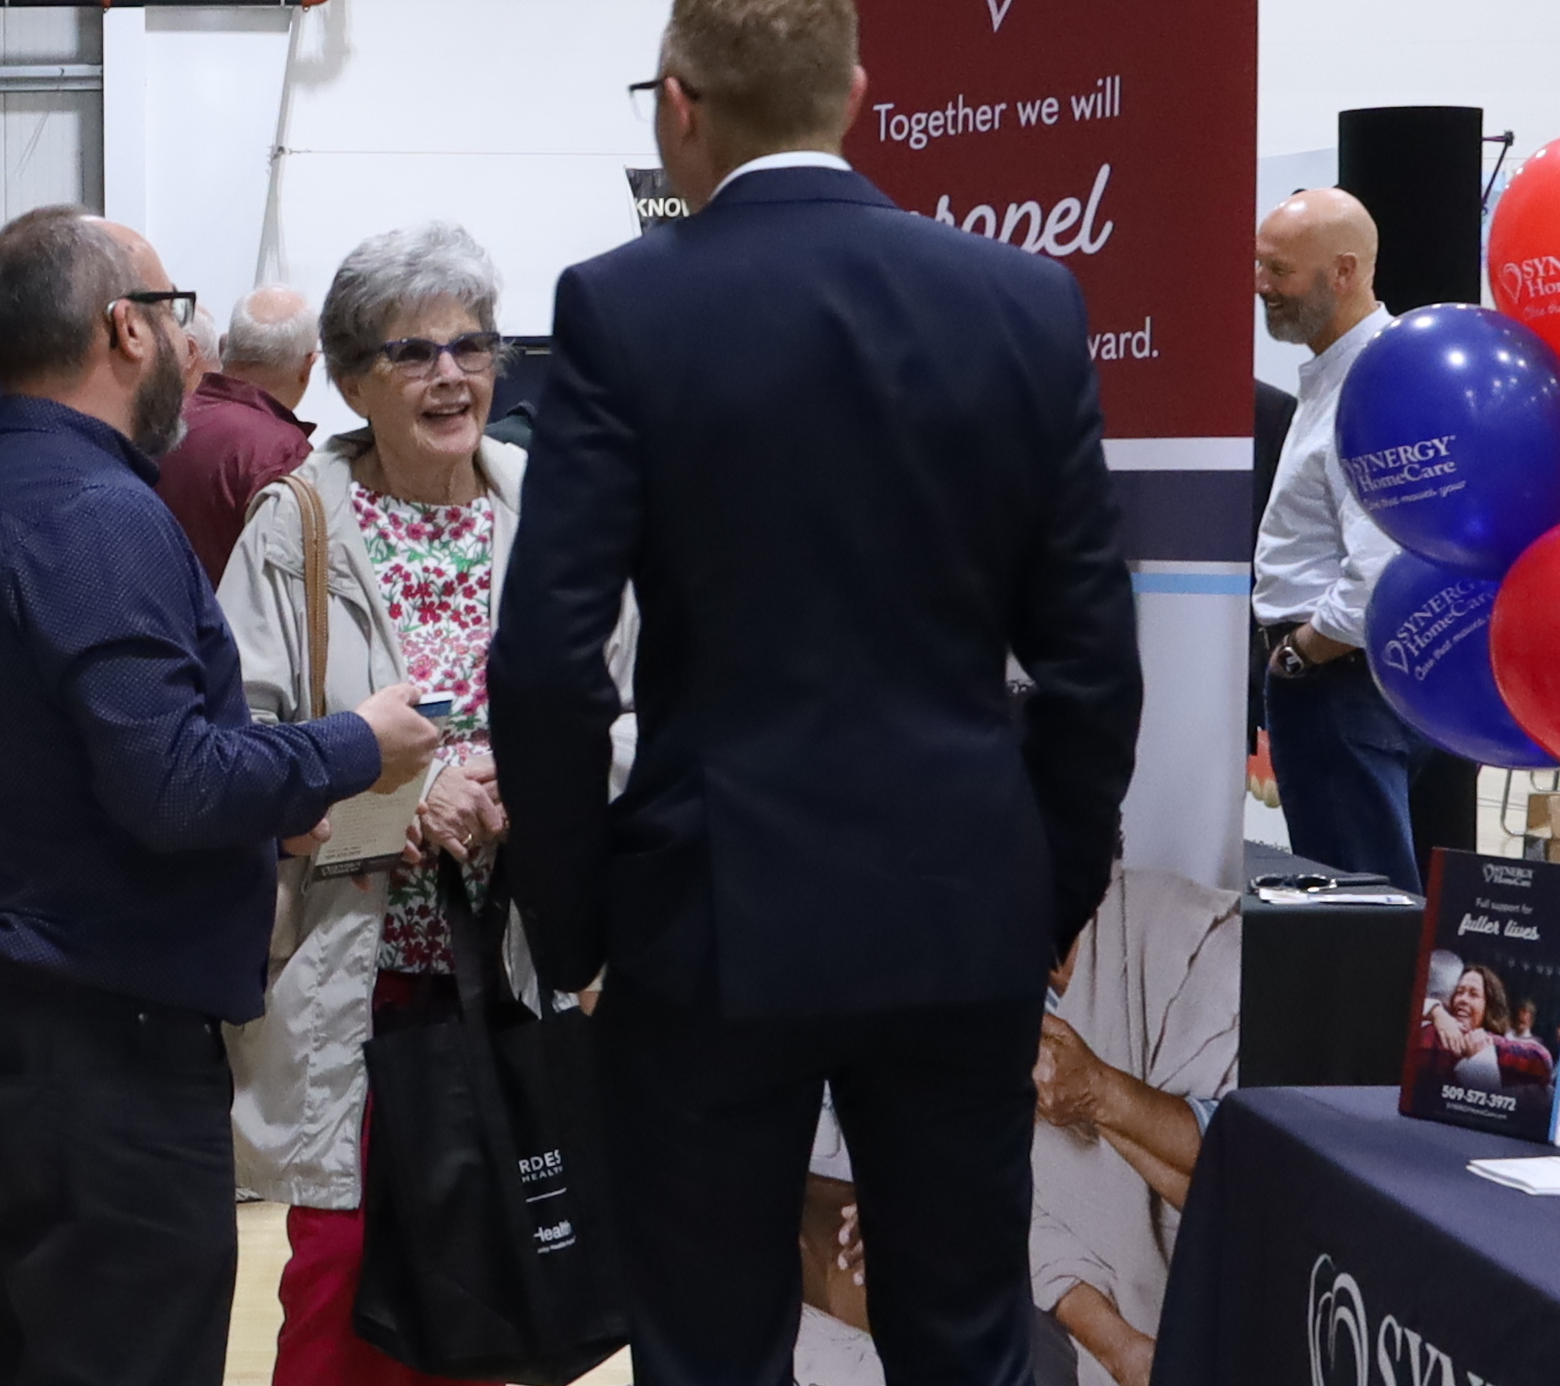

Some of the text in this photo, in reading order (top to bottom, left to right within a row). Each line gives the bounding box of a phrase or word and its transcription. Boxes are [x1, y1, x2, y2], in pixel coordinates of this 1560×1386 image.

[872, 75, 1120, 150] Together we will
[1359, 461, 1457, 493] HomeCare
[1458, 913, 1540, 941] fuller lives
[1441, 1084, 1517, 1112] 509-572-3972
